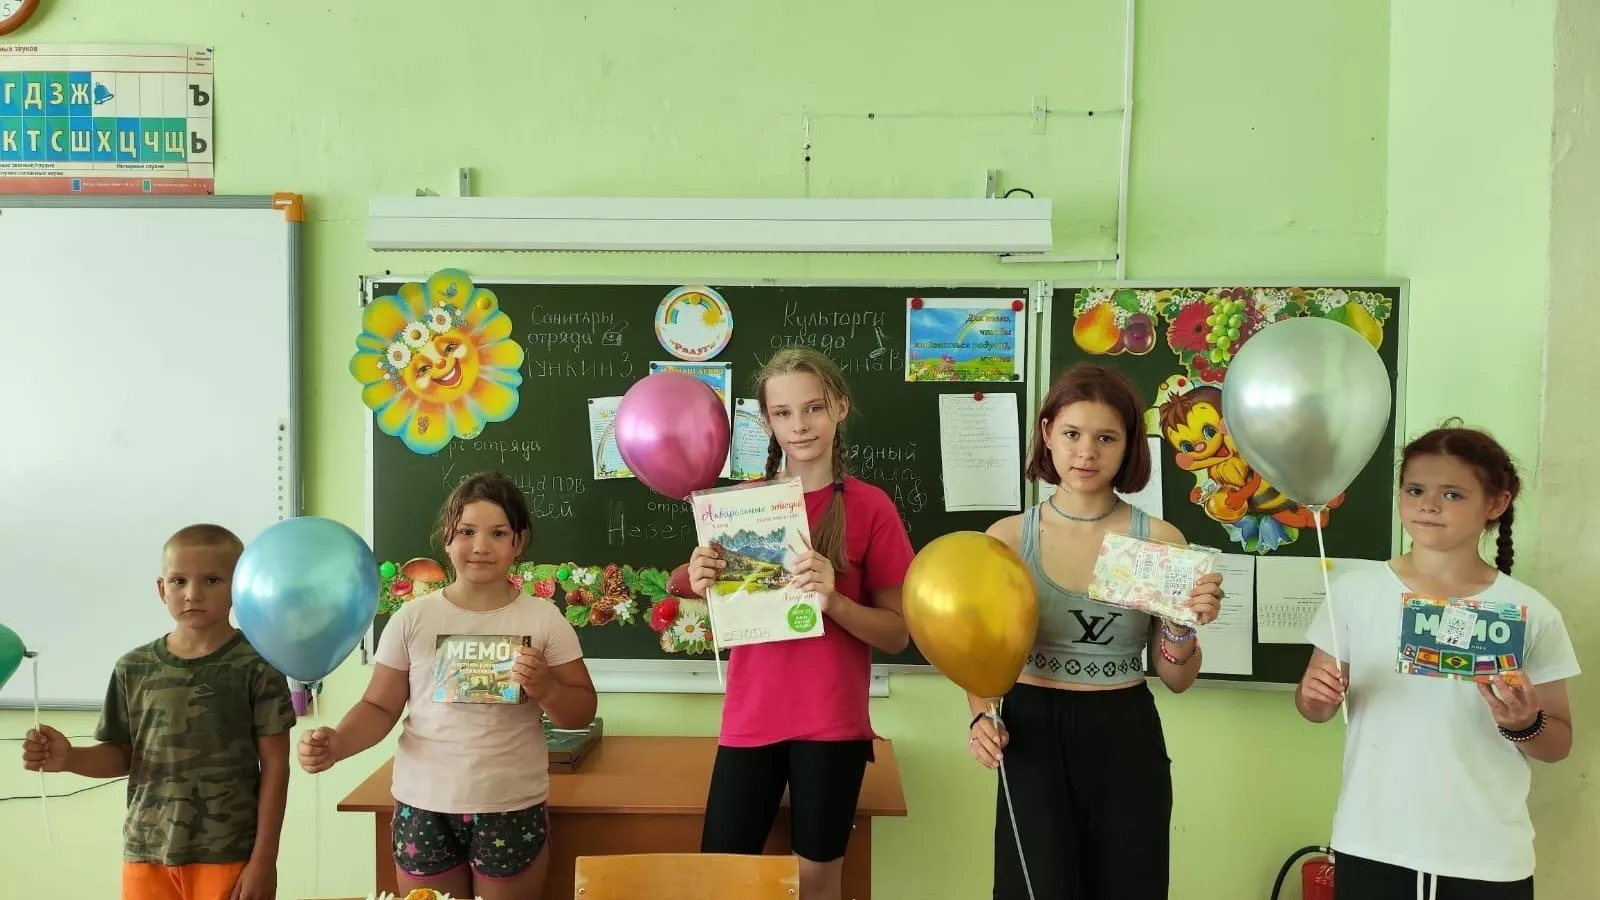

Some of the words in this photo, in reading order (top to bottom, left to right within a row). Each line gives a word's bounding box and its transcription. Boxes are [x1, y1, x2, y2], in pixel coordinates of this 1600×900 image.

[3, 3, 11, 17] 5
[4, 82, 16, 105] Г
[24, 82, 42, 110] Д
[50, 83, 64, 105] З
[71, 82, 90, 105] Ж
[189, 84, 210, 106] Ъ
[3, 130, 18, 152] К
[27, 130, 40, 152] Т
[51, 130, 63, 152] С
[71, 130, 91, 152] Ш
[97, 130, 112, 152] Х
[119, 131, 137, 159] Ц
[144, 131, 159, 152] Ч
[165, 131, 185, 159] Щ
[191, 131, 207, 154] Ь
[531, 304, 615, 335] Санитары
[783, 300, 887, 339] Культорги
[527, 332, 593, 353] отряда
[473, 439, 542, 464] отряда
